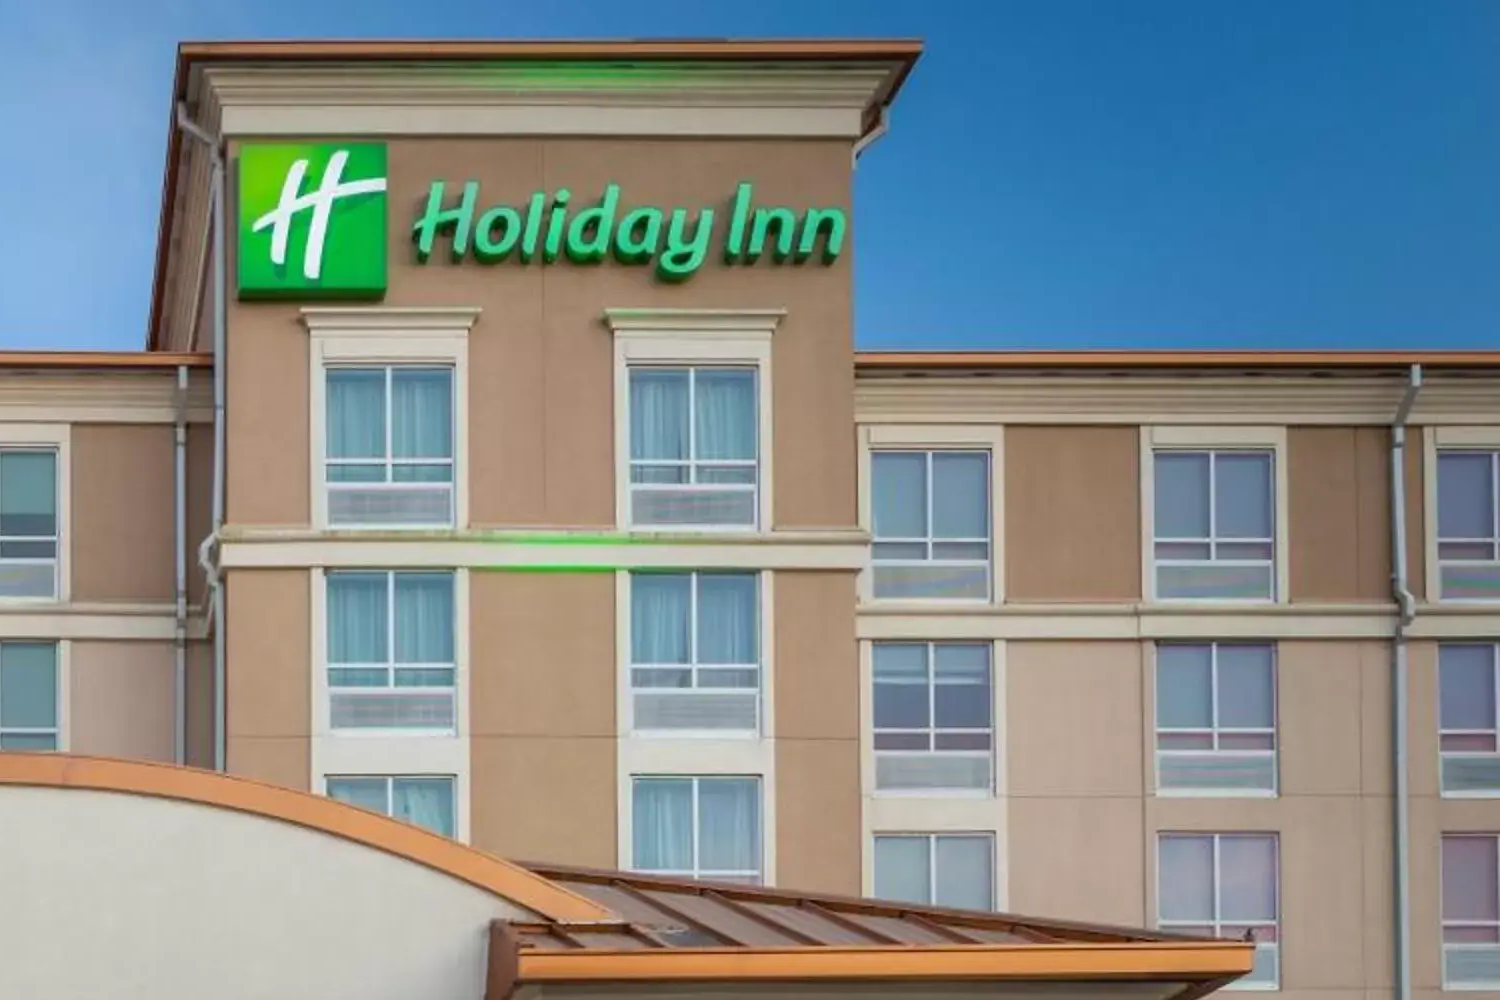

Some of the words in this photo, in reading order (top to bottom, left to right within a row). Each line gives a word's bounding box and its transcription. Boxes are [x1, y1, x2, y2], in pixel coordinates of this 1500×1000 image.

[252, 150, 386, 279] H
[413, 181, 712, 273] Holiday
[727, 182, 846, 260] Inn
